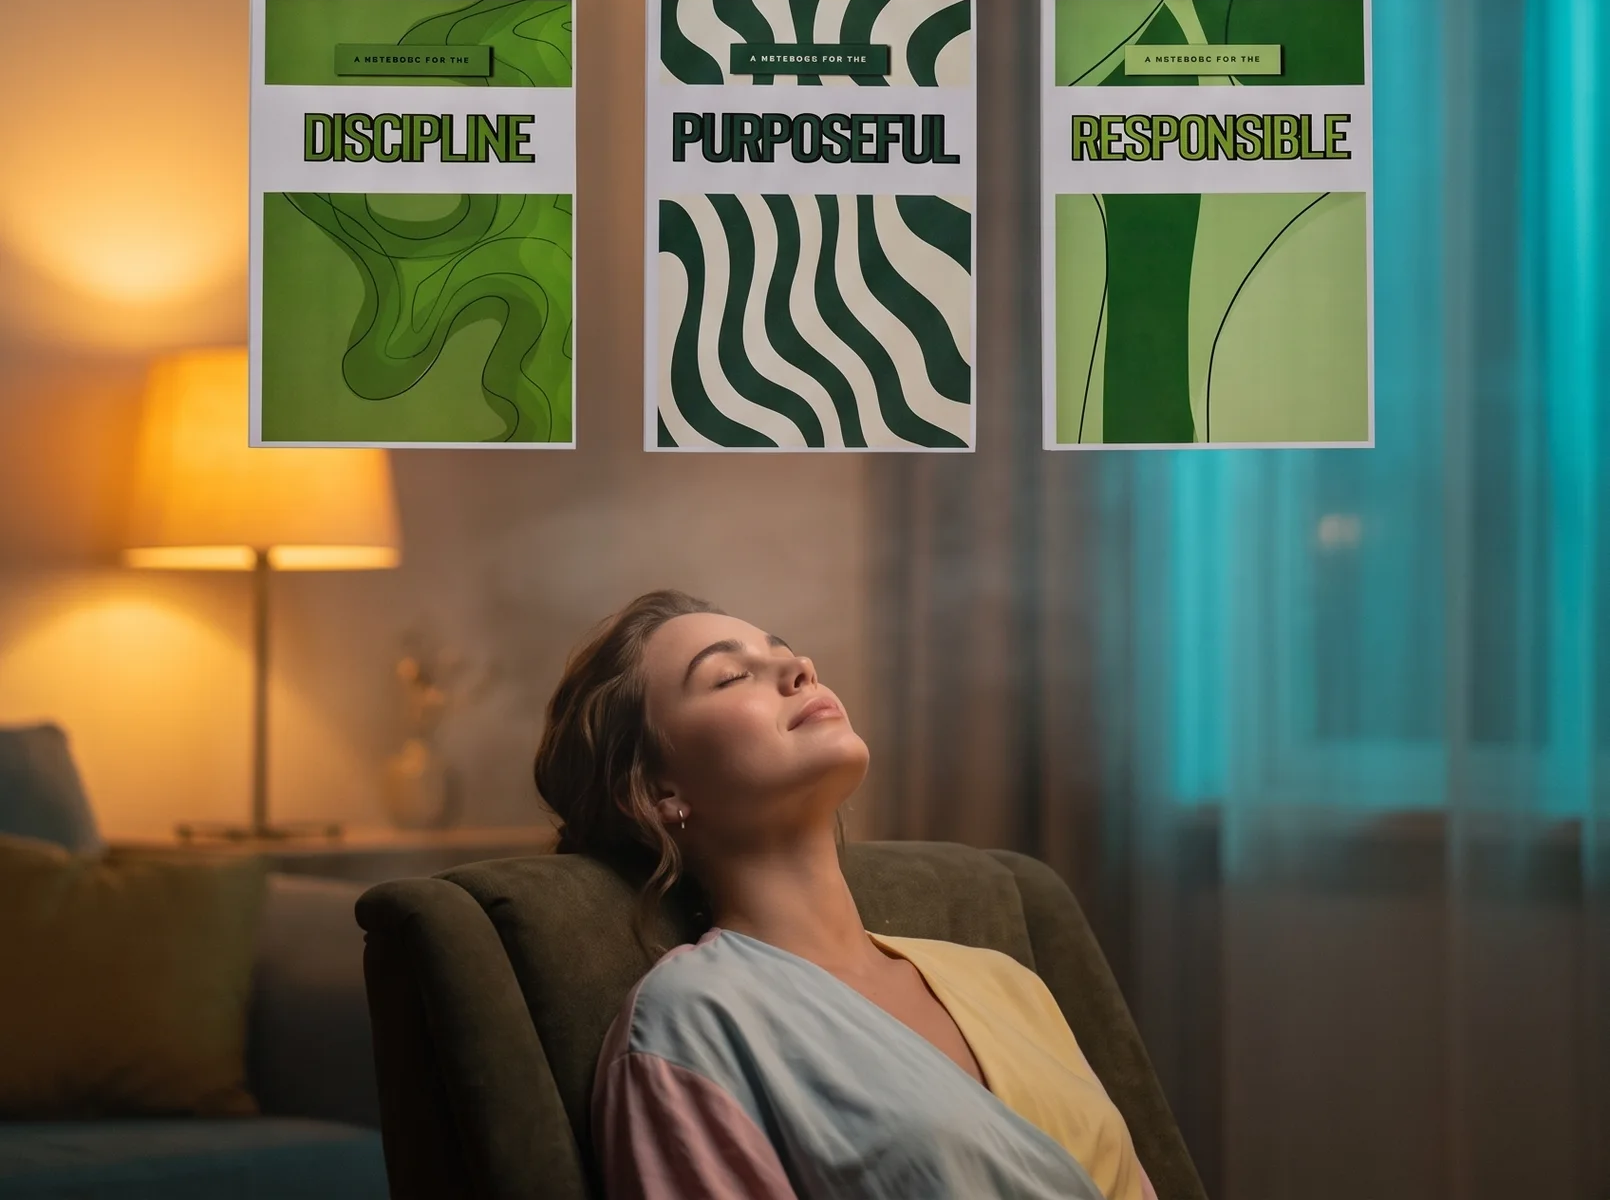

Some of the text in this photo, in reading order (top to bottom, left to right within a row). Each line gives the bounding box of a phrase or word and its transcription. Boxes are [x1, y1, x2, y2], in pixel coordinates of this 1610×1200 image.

[425, 56, 446, 64] FOR
[450, 56, 469, 64] THE
[822, 55, 843, 63] FOR
[847, 55, 867, 63] THE
[1216, 55, 1237, 63] FOR
[1240, 55, 1260, 63] THE
[304, 112, 536, 163] DISCIPLINE
[672, 112, 961, 164] PURPOSEFUL
[1071, 113, 1352, 162] RESPONSIBLE
